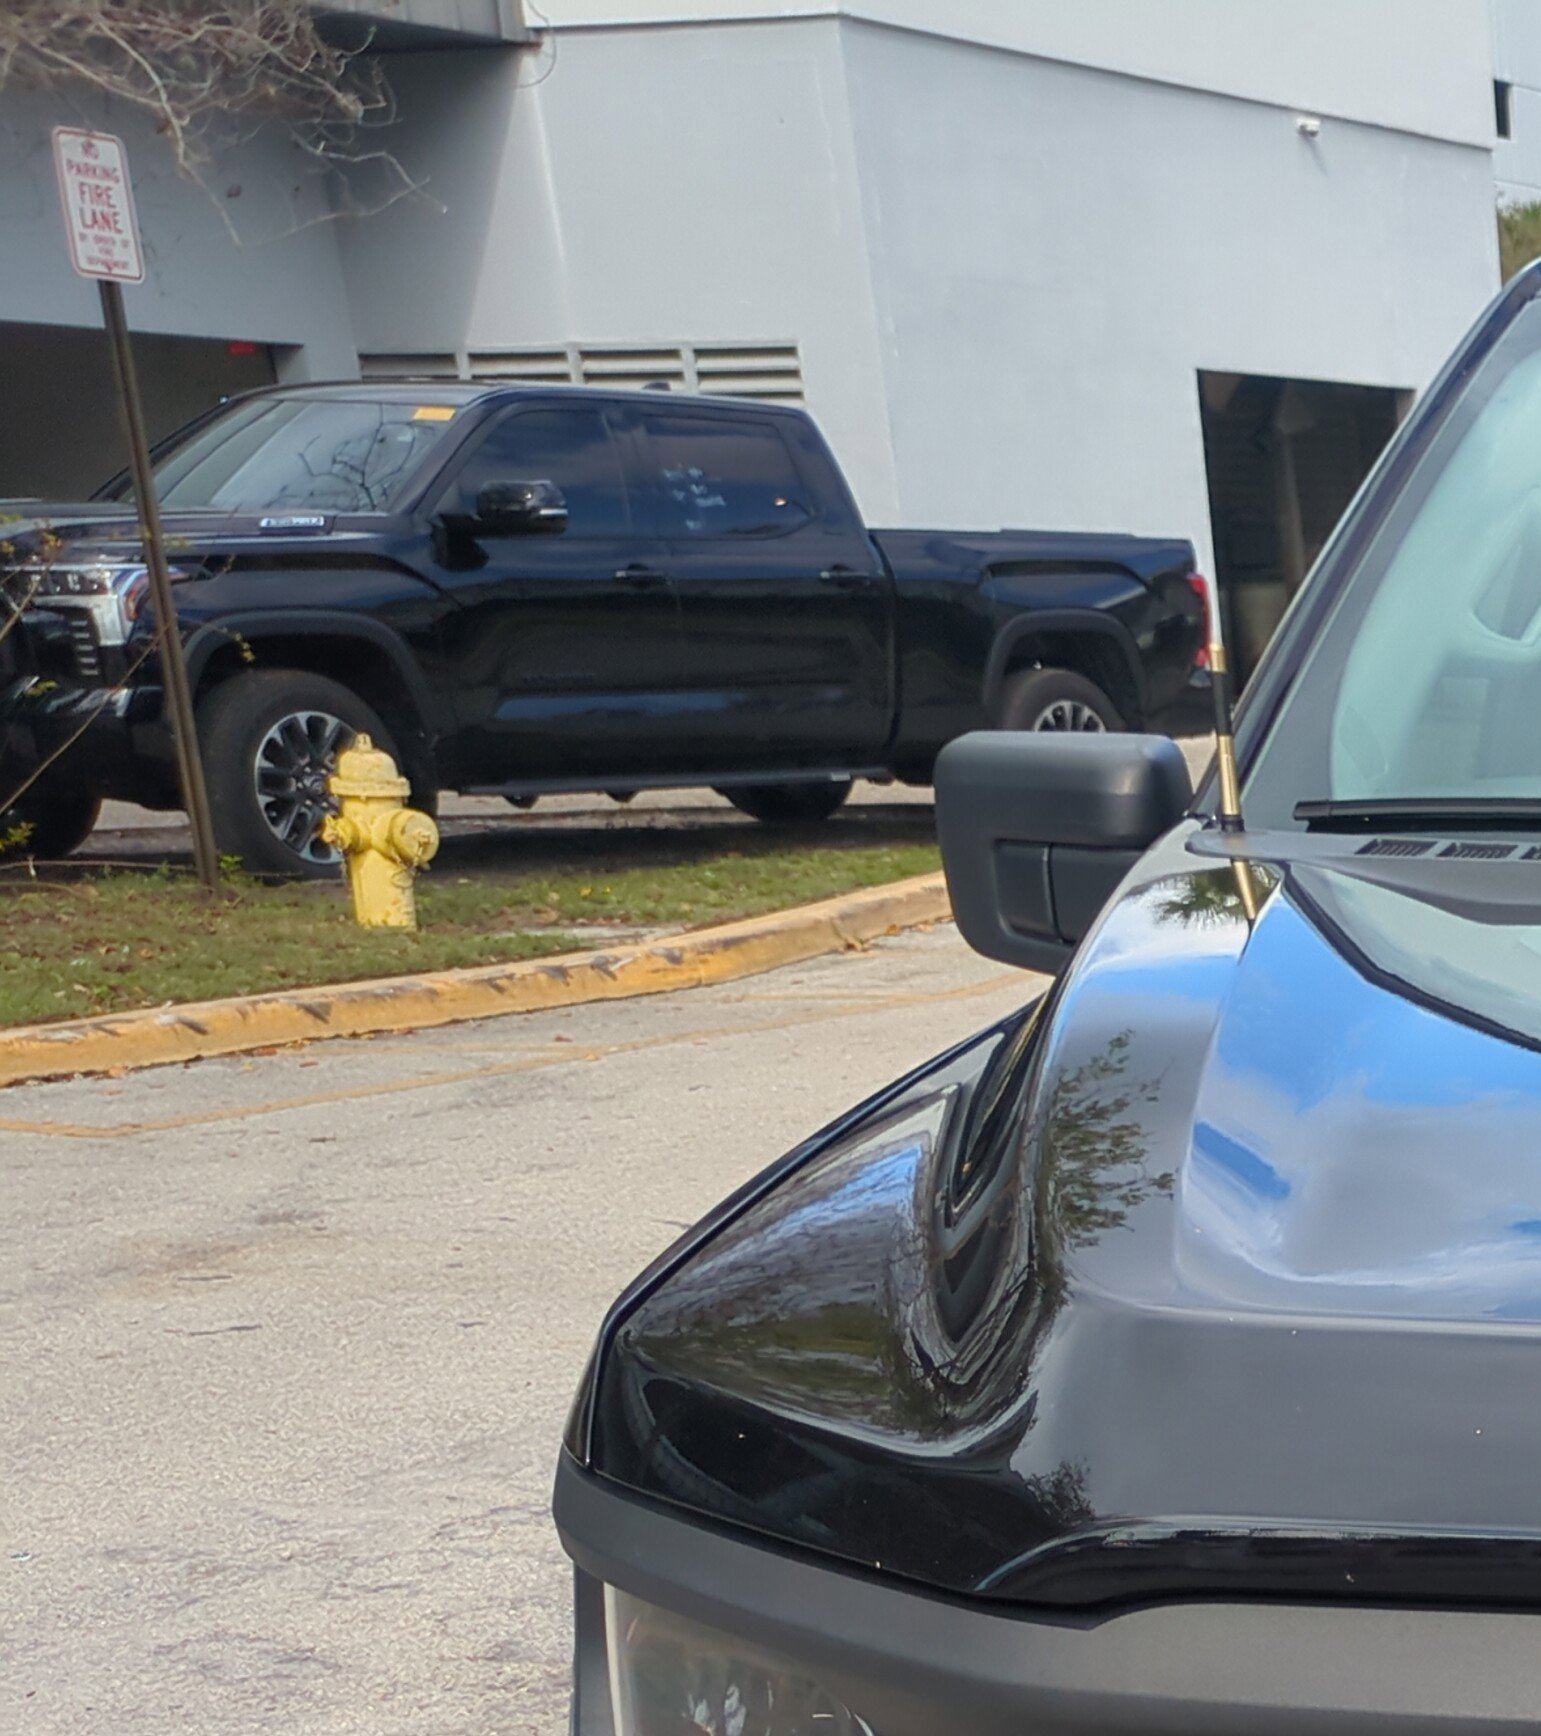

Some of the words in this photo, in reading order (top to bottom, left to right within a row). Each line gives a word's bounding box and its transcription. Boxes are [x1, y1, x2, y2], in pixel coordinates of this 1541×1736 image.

[66, 158, 120, 184] PARKING
[78, 181, 117, 209] FIRE
[79, 206, 124, 234] LANE
